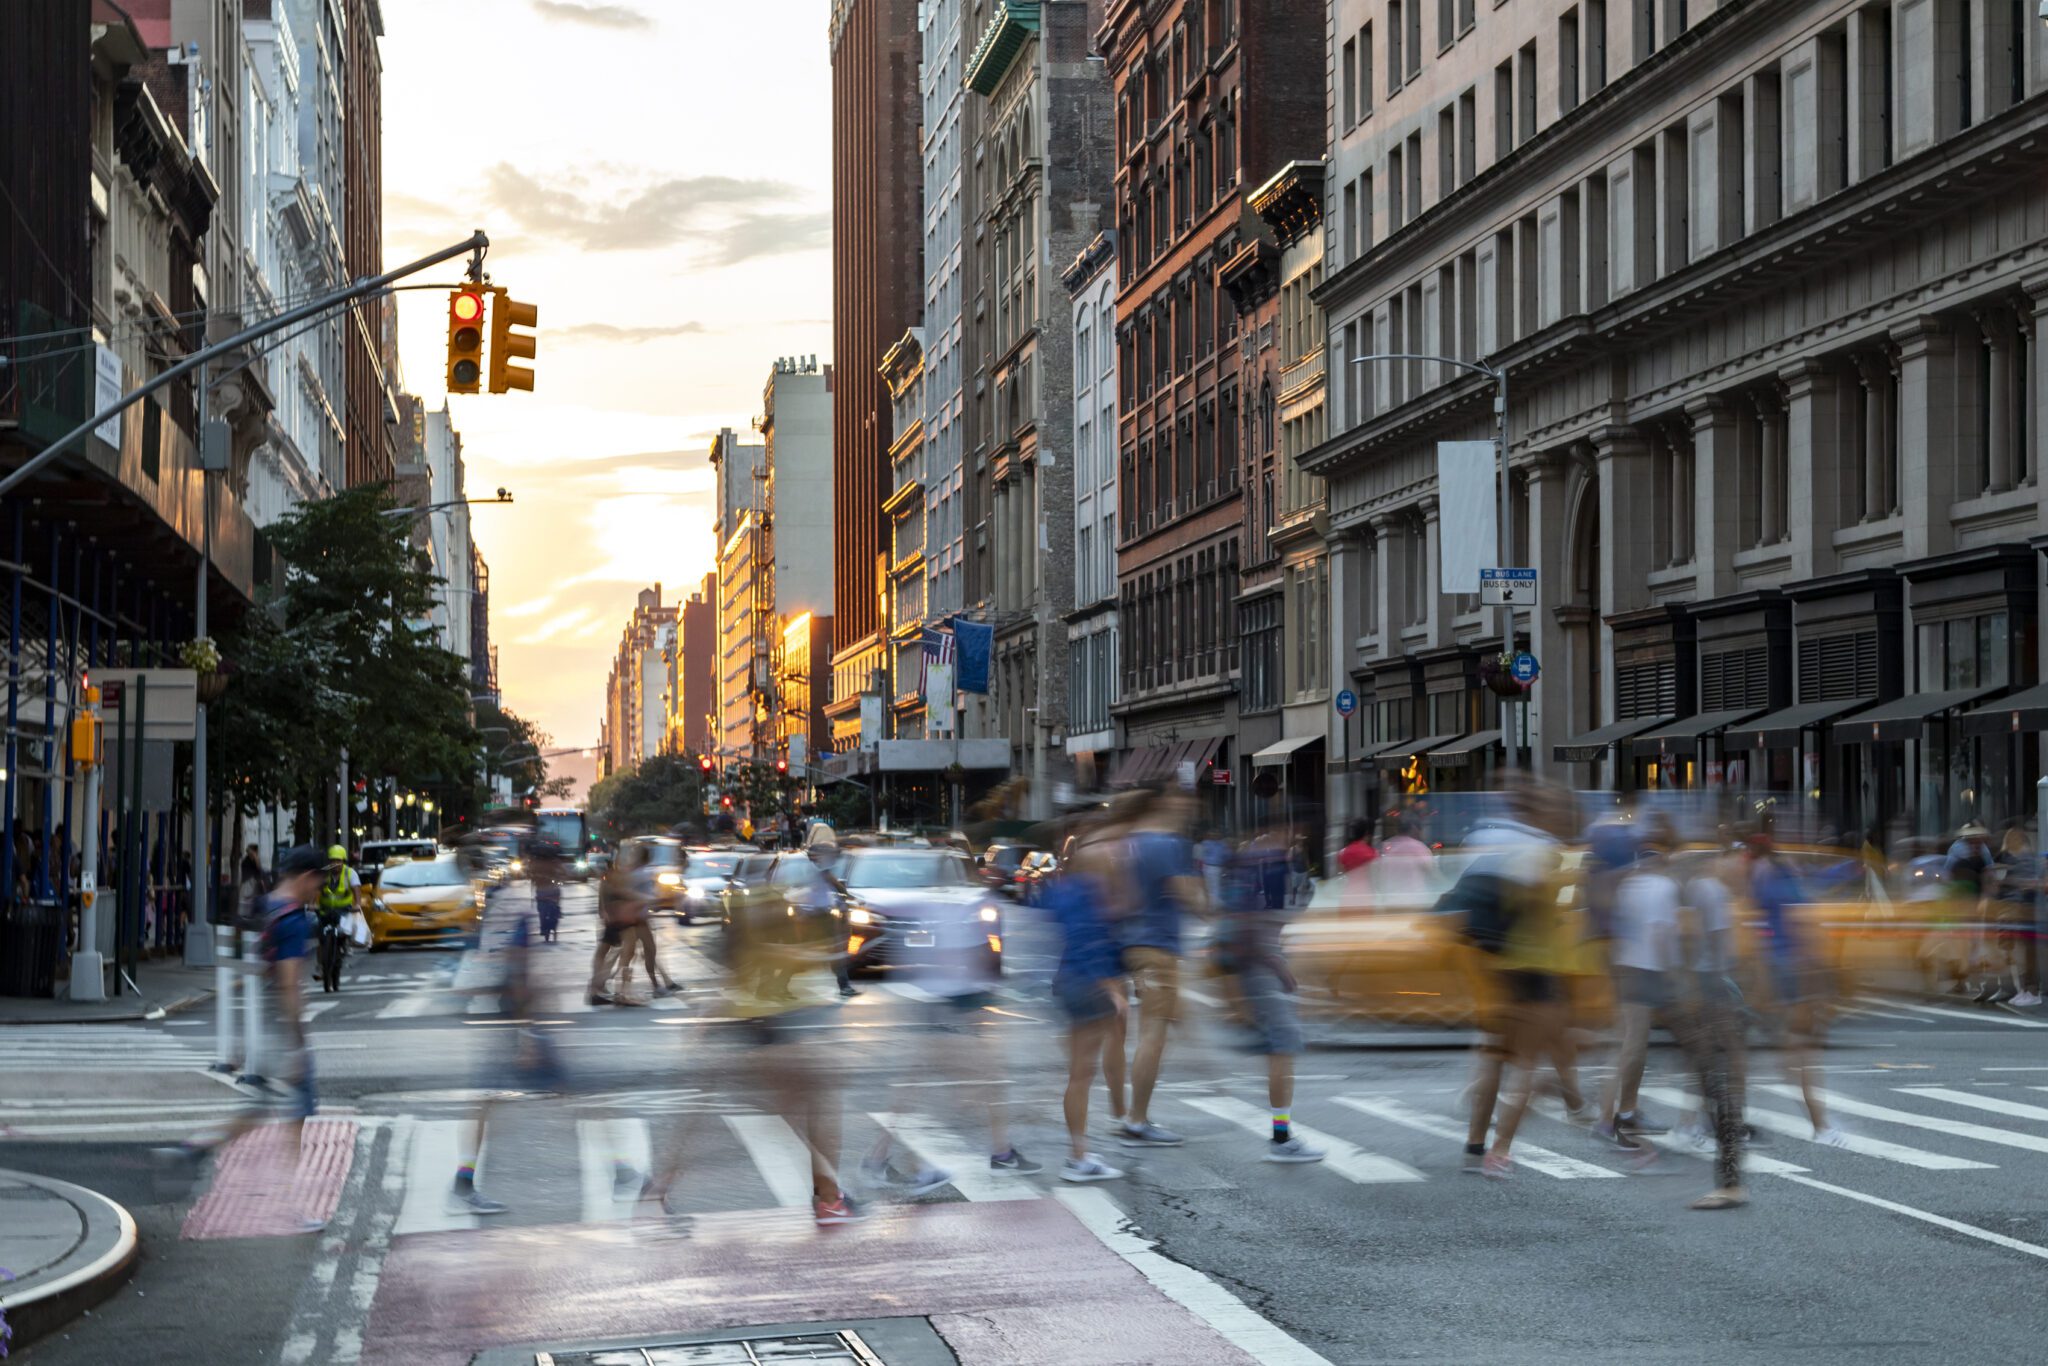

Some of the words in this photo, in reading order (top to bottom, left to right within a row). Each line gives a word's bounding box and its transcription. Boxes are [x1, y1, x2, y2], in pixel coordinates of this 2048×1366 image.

[1495, 570, 1510, 578] BUS
[1512, 570, 1533, 578] LANE
[1483, 580, 1510, 588] BUSES
[1513, 580, 1533, 588] ONLY
